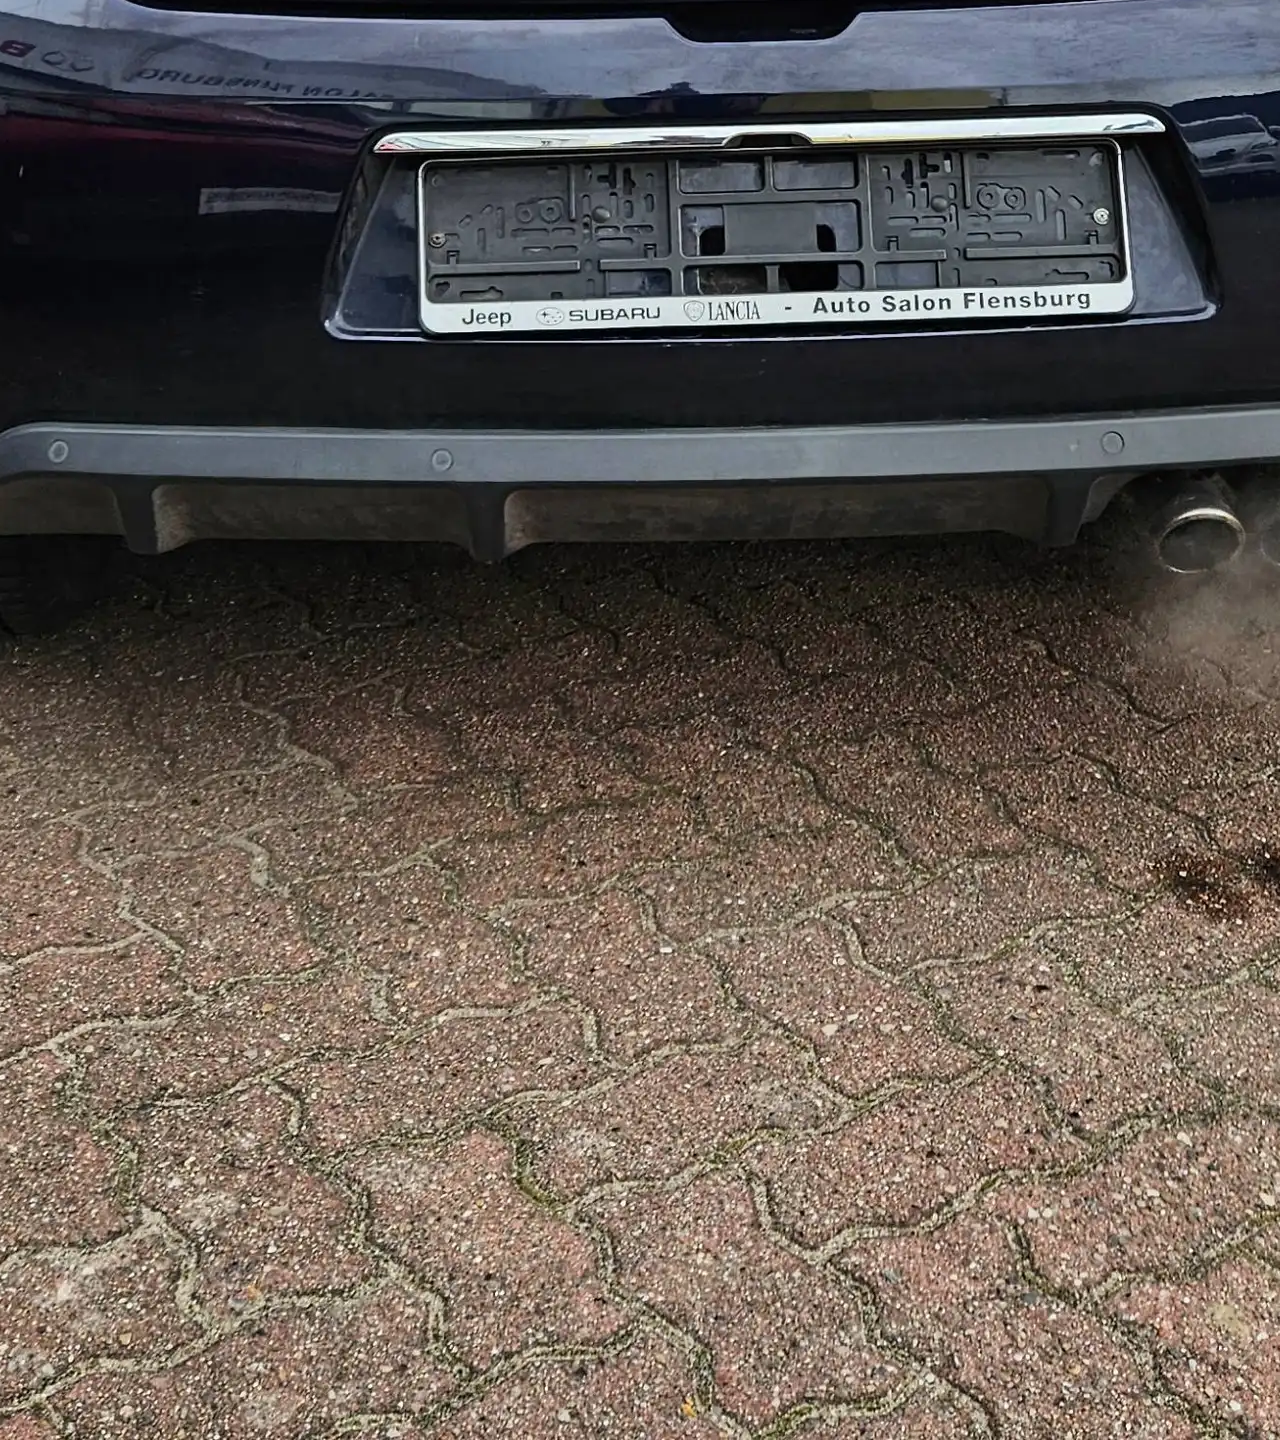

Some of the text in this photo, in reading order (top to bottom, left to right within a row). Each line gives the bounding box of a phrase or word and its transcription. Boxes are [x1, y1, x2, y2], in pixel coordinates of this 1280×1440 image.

[462, 308, 513, 327] Jeep
[568, 307, 661, 322] SUBARU
[708, 300, 761, 321] LANCIA
[812, 296, 871, 314] Auto
[881, 294, 952, 312] Salon
[963, 291, 1091, 311] Flensburg
